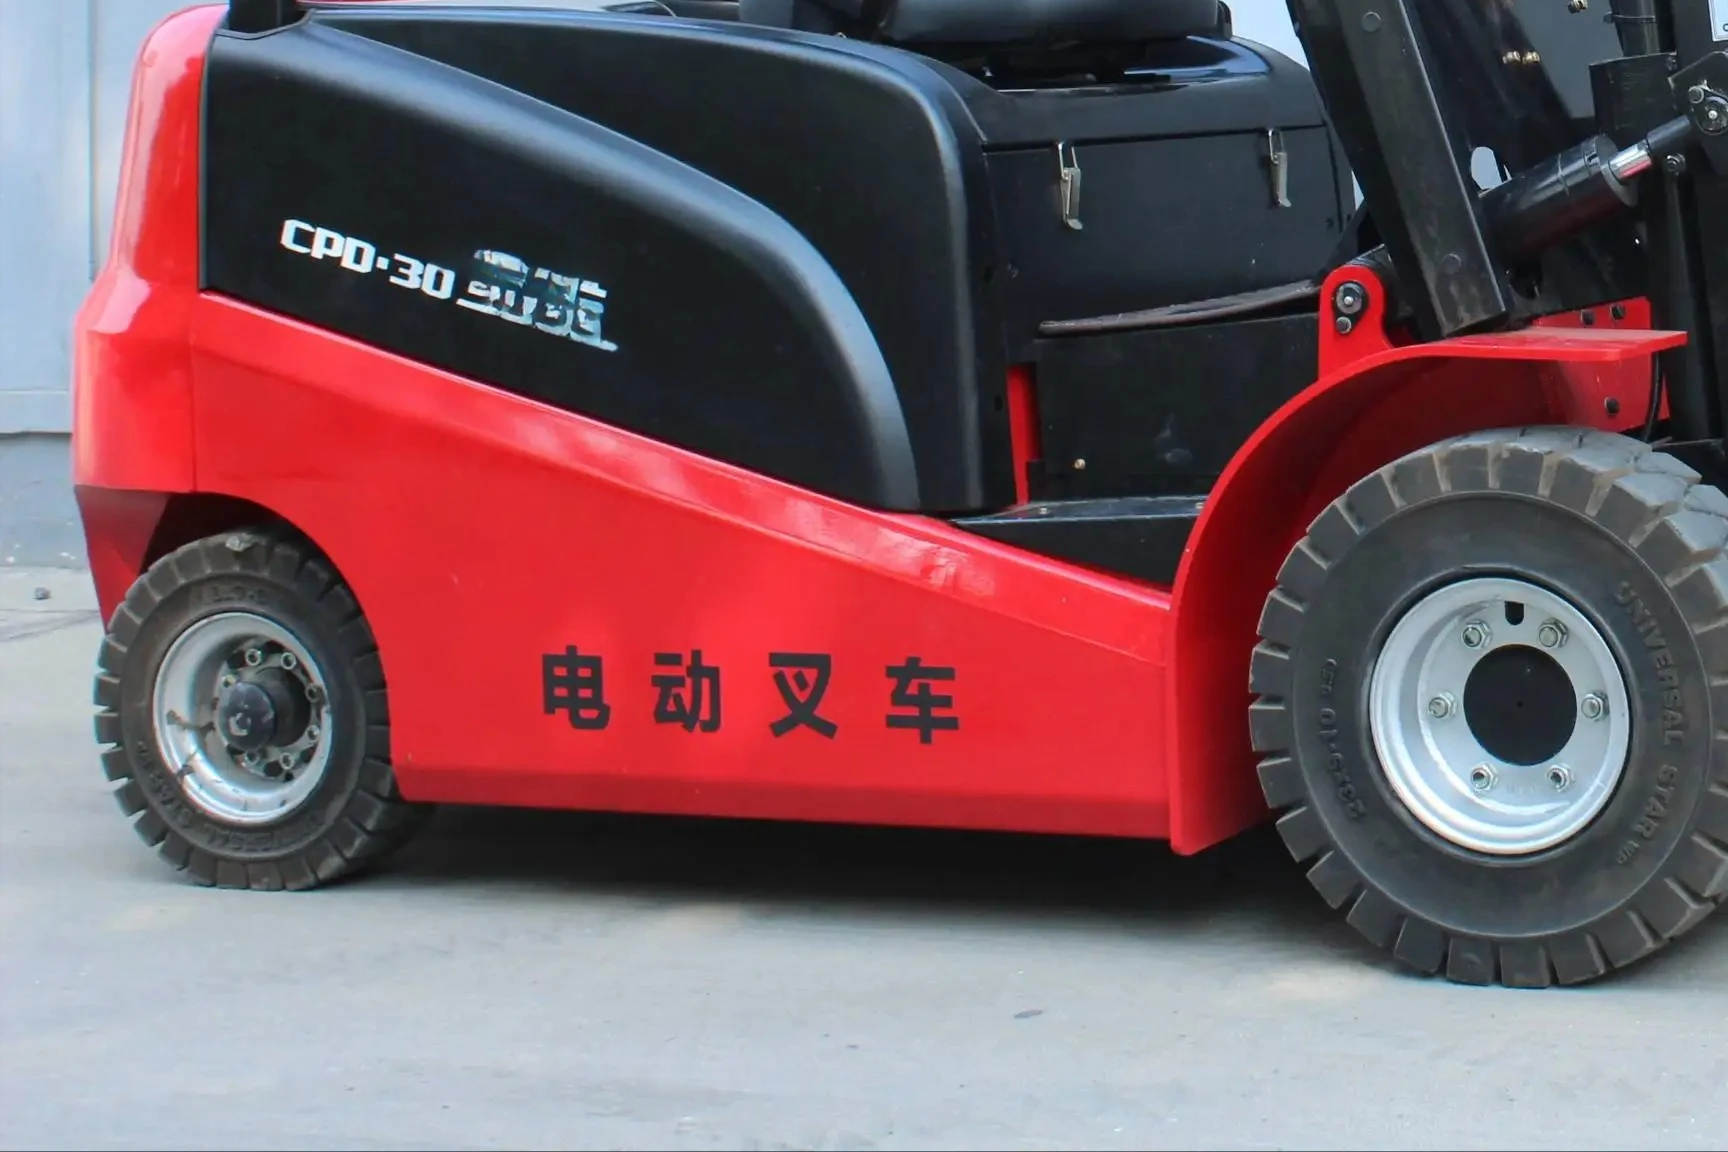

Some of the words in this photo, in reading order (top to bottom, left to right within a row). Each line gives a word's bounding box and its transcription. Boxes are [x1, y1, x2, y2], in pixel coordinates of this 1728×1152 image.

[541, 644, 959, 745] 电动叉车
[1615, 580, 1685, 746] UNIVERSAL
[1632, 763, 1679, 840] STAR
